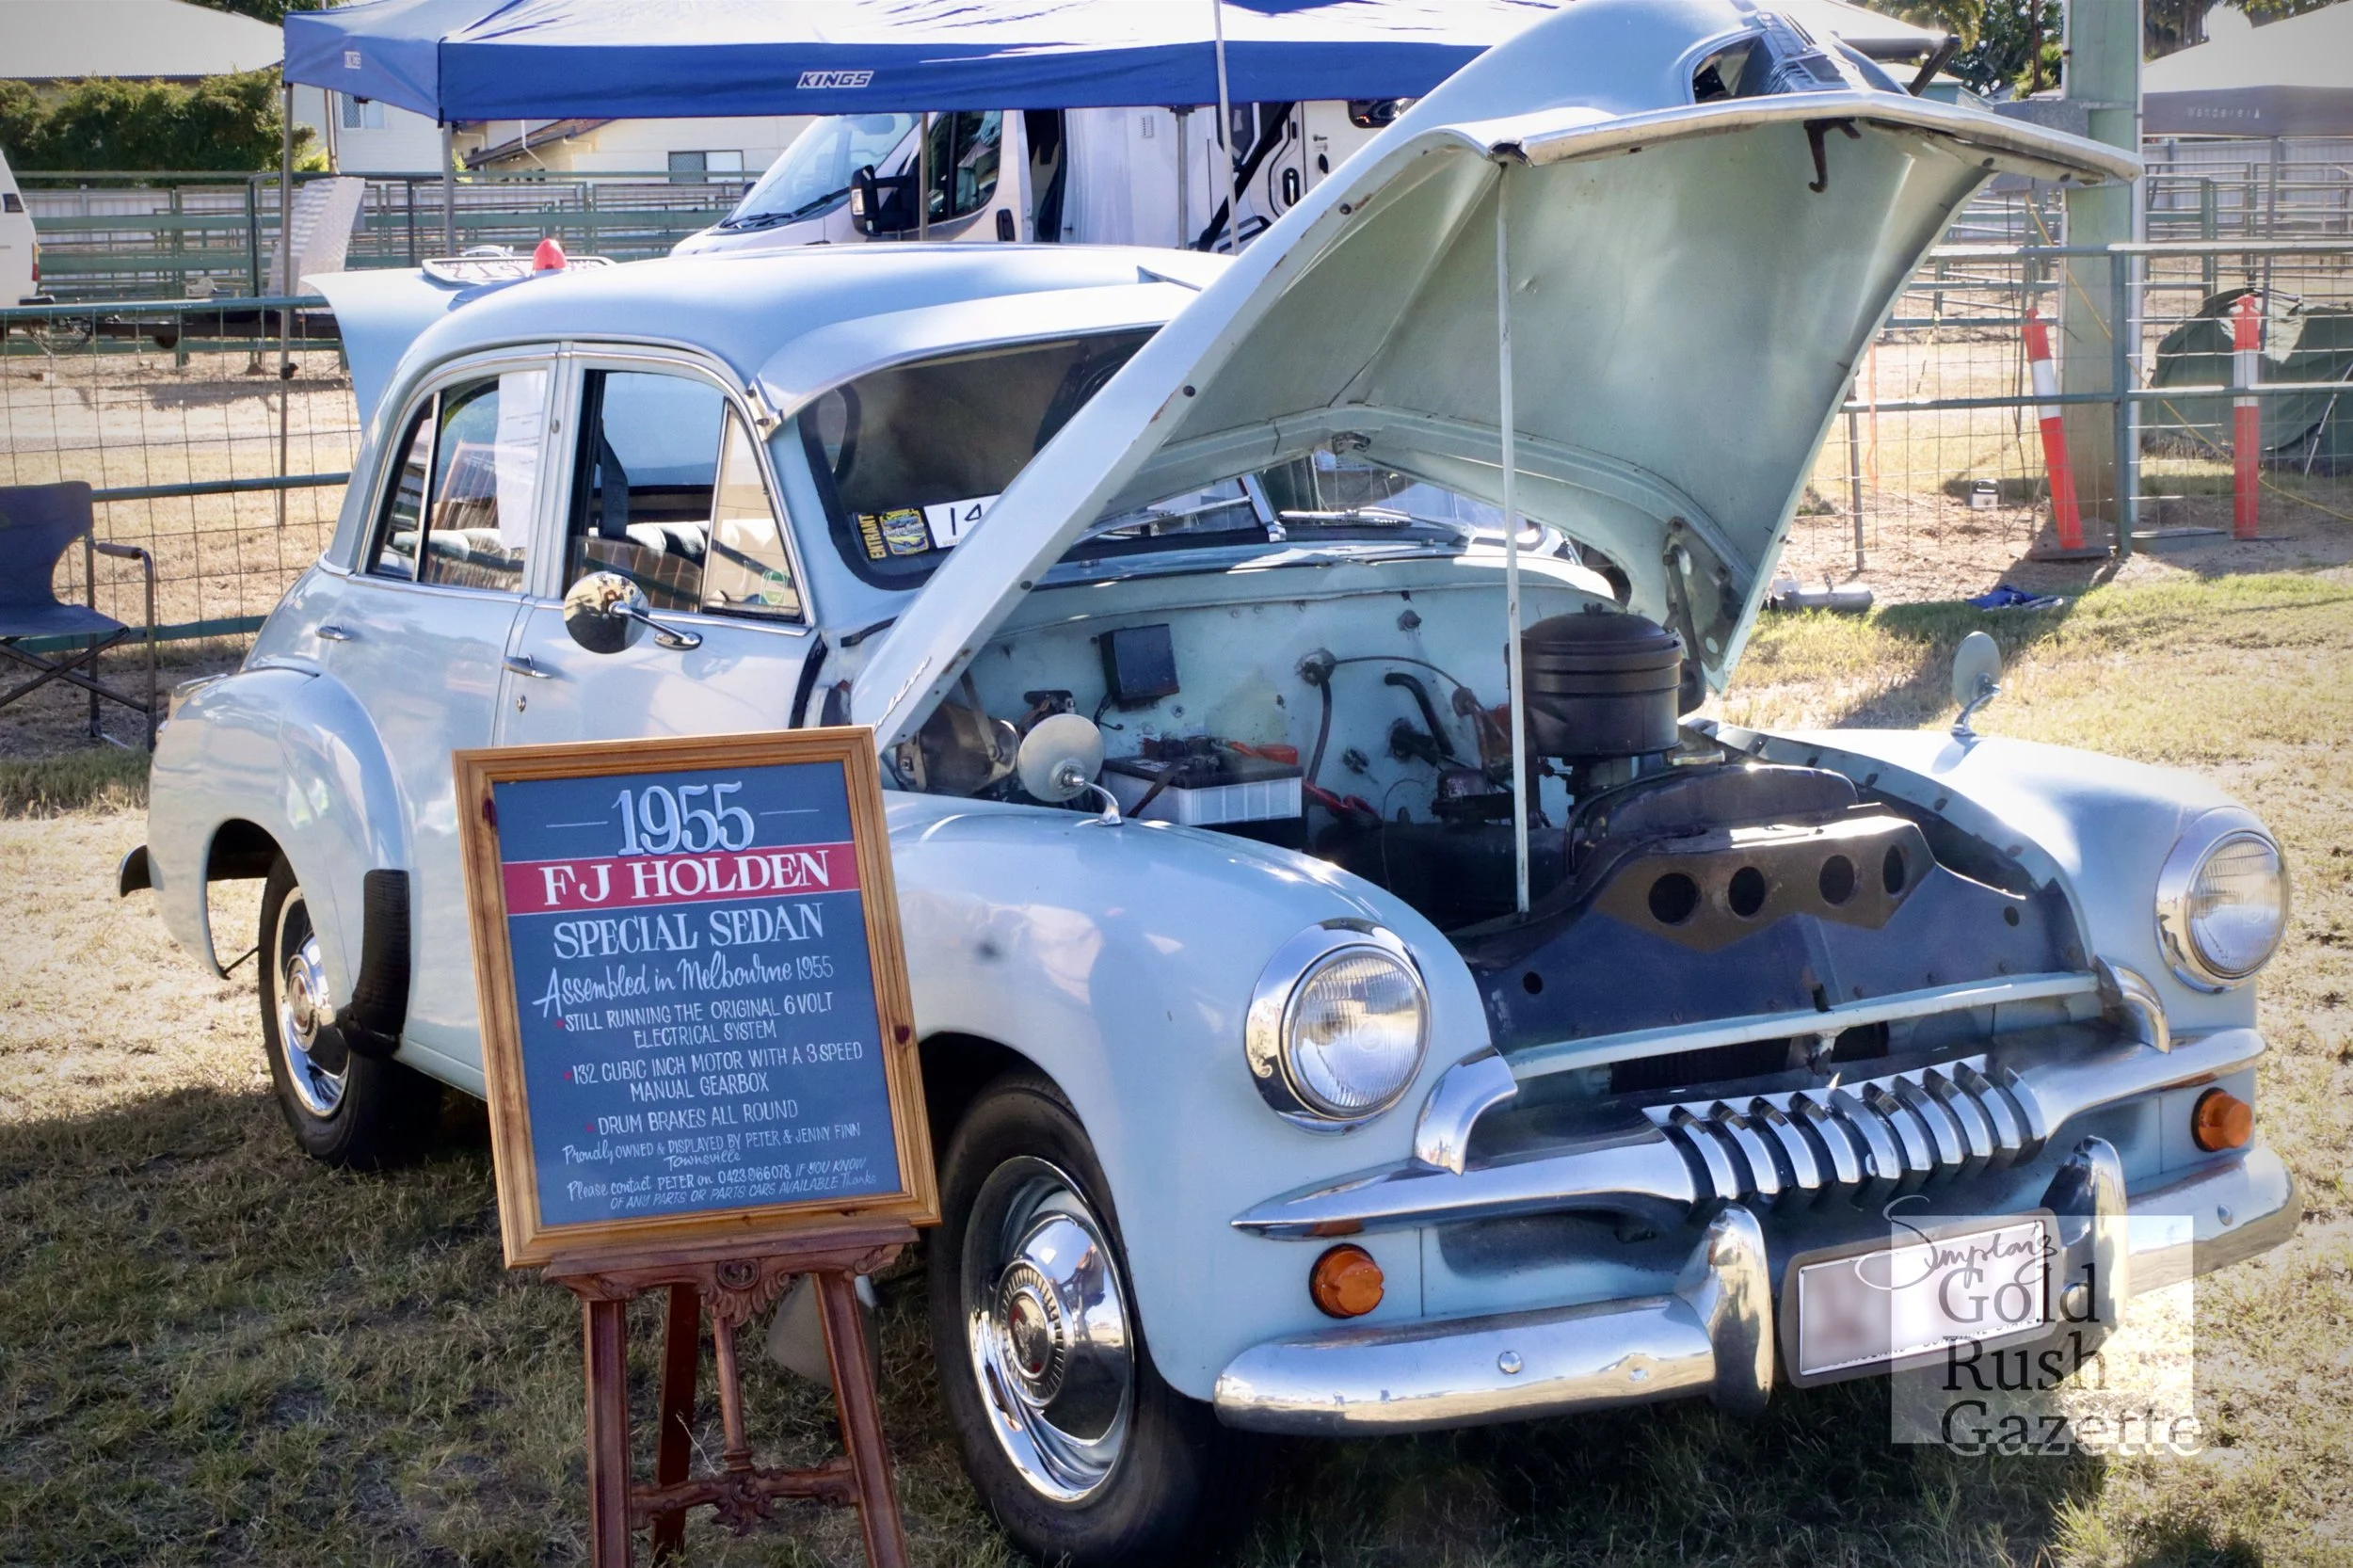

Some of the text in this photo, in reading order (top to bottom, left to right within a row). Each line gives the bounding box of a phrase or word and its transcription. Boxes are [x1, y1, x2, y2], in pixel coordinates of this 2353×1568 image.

[797, 71, 873, 88] KINGS
[857, 514, 888, 559] ENTRANT
[611, 780, 755, 856] 1955
[538, 850, 829, 906] FJ HOLDEN
[553, 902, 824, 960] SPECIAL SEDAN
[532, 951, 834, 1019] Assembled in Melbourne 1955
[565, 1012, 602, 1032] STILL
[606, 1005, 672, 1029] RUNNING
[674, 1002, 703, 1022] THE
[711, 998, 781, 1019] ORIGINAL
[633, 1019, 777, 1049] ELECTRICAL SYSTEM
[572, 1063, 599, 1084] 132
[601, 1059, 647, 1081] CUBIC
[651, 1055, 686, 1078] INCH
[691, 1050, 744, 1073] MOTOR
[747, 1048, 788, 1068] WITH
[792, 1046, 803, 1065] A
[630, 1072, 770, 1102] MANUAL GEARBOX
[598, 1099, 798, 1136] DRUM BRAKES ALL ROUND
[562, 1122, 861, 1165] Proudly OWNED & DISPLAYED BY PETER & JENNY FINN
[664, 1149, 742, 1172] Townsville
[568, 1180, 609, 1202] Please
[611, 1175, 651, 1195] contact
[658, 1174, 695, 1192] PETER
[696, 1175, 713, 1186] on
[795, 1163, 807, 1177] IF
[832, 1157, 867, 1174] KNOW
[610, 1195, 625, 1210] OF
[626, 1194, 651, 1210] ANY
[653, 1191, 687, 1207] PARTS
[690, 1190, 707, 1202] OR
[710, 1185, 746, 1201] PARTS
[748, 1182, 776, 1197] CARS
[779, 1176, 839, 1194] AVAILABLE
